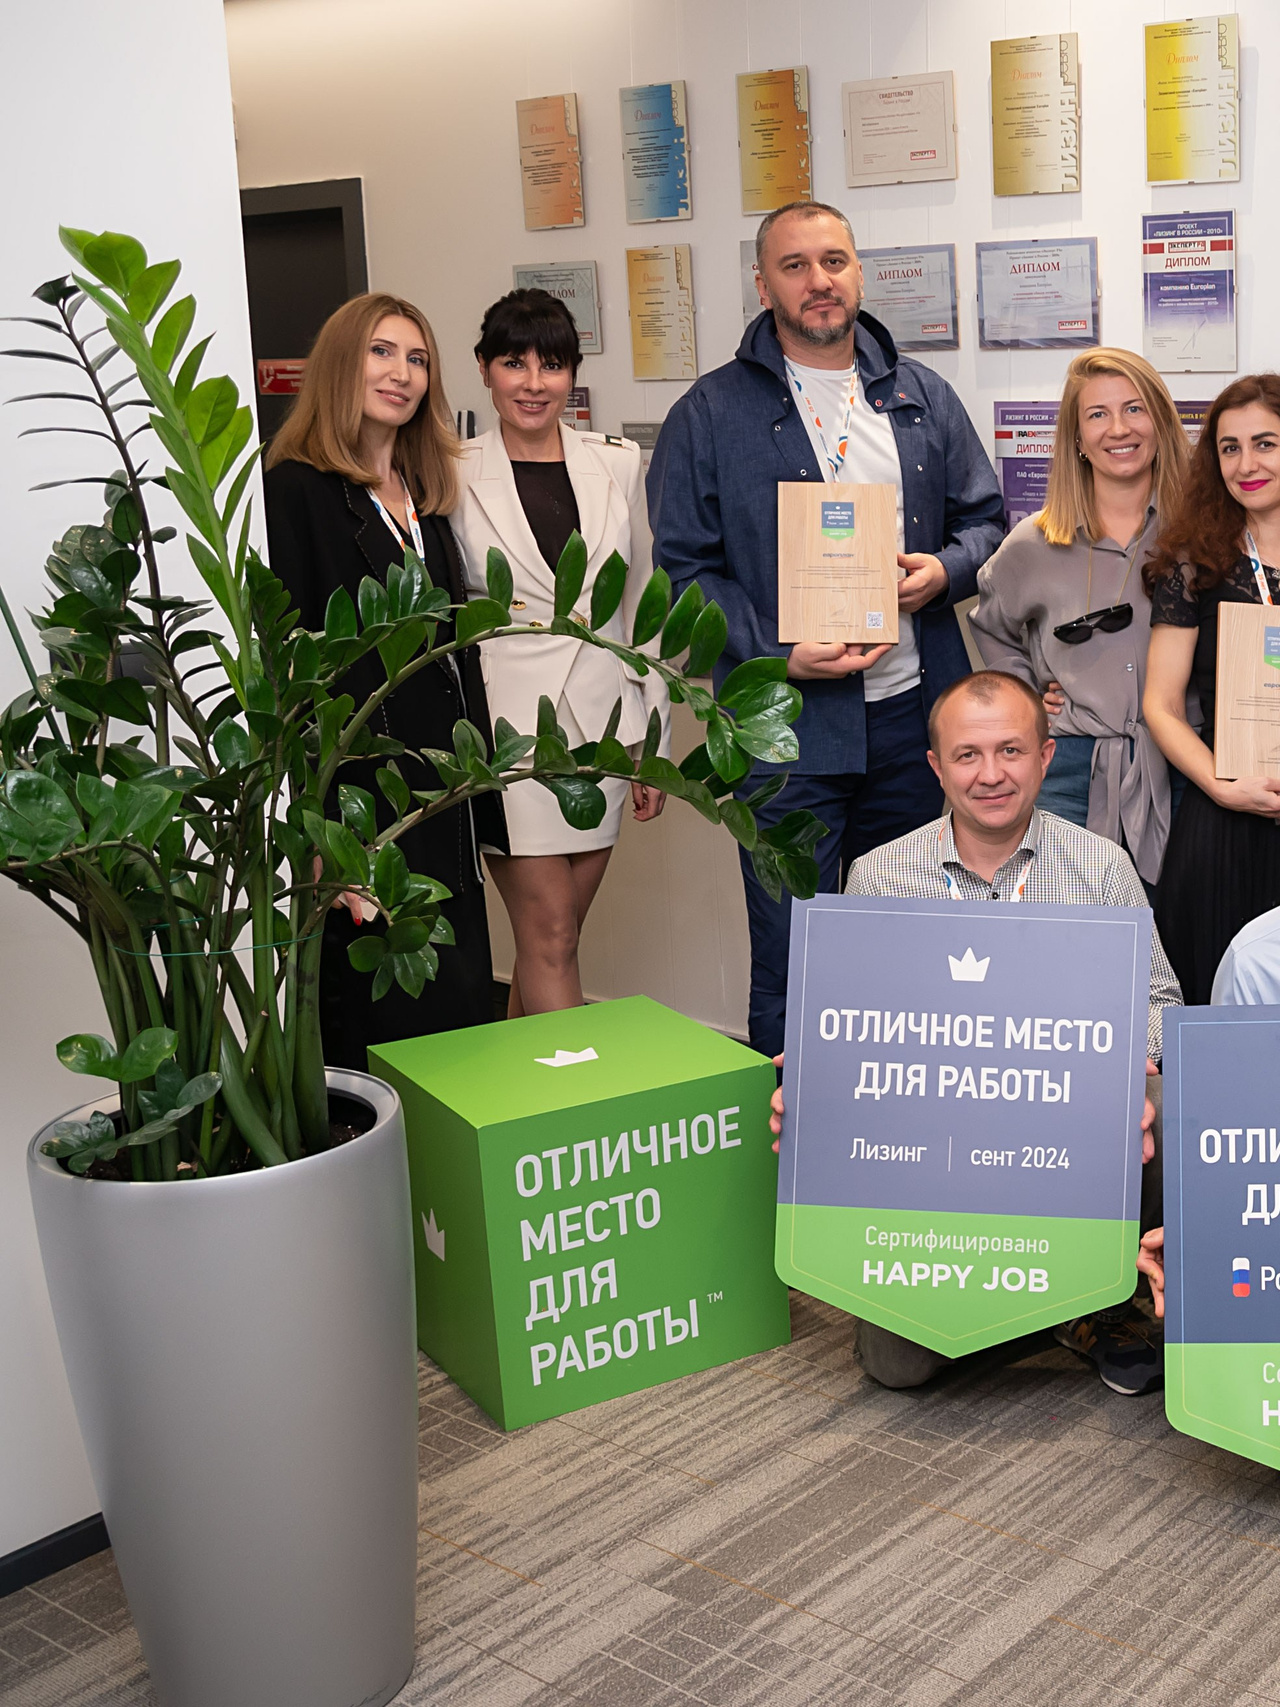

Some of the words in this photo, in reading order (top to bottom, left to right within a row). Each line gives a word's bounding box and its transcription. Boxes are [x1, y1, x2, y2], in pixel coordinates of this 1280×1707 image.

[1011, 68, 1043, 82] Диплом
[1166, 53, 1200, 66] Диплом
[876, 268, 922, 281] ДИПЛОМ
[1010, 262, 1060, 274] ДИПЛОМ
[1165, 256, 1211, 269] ДИПЛОМ
[550, 289, 576, 299] ПЛОМ
[1190, 283, 1216, 291] Europlan
[818, 1008, 995, 1049] ОТЛИЧНОЕ
[1004, 1018, 1113, 1053] МЕСТО
[854, 1062, 926, 1100] ДЛЯ
[939, 1067, 1070, 1103] РАБОТЫ
[514, 1106, 742, 1198] ОТЛИЧНОЕ
[850, 1138, 927, 1163] Лизинг
[970, 1148, 1016, 1167] сент
[1021, 1146, 1070, 1170] 2024
[520, 1187, 661, 1262] МЕСТО
[864, 1226, 1050, 1256] Сертифицировано
[862, 1260, 974, 1289] HAPPY
[983, 1266, 1049, 1293] JOB
[524, 1258, 618, 1331] ДЛЯ
[530, 1298, 699, 1386] РАБОТЫ
